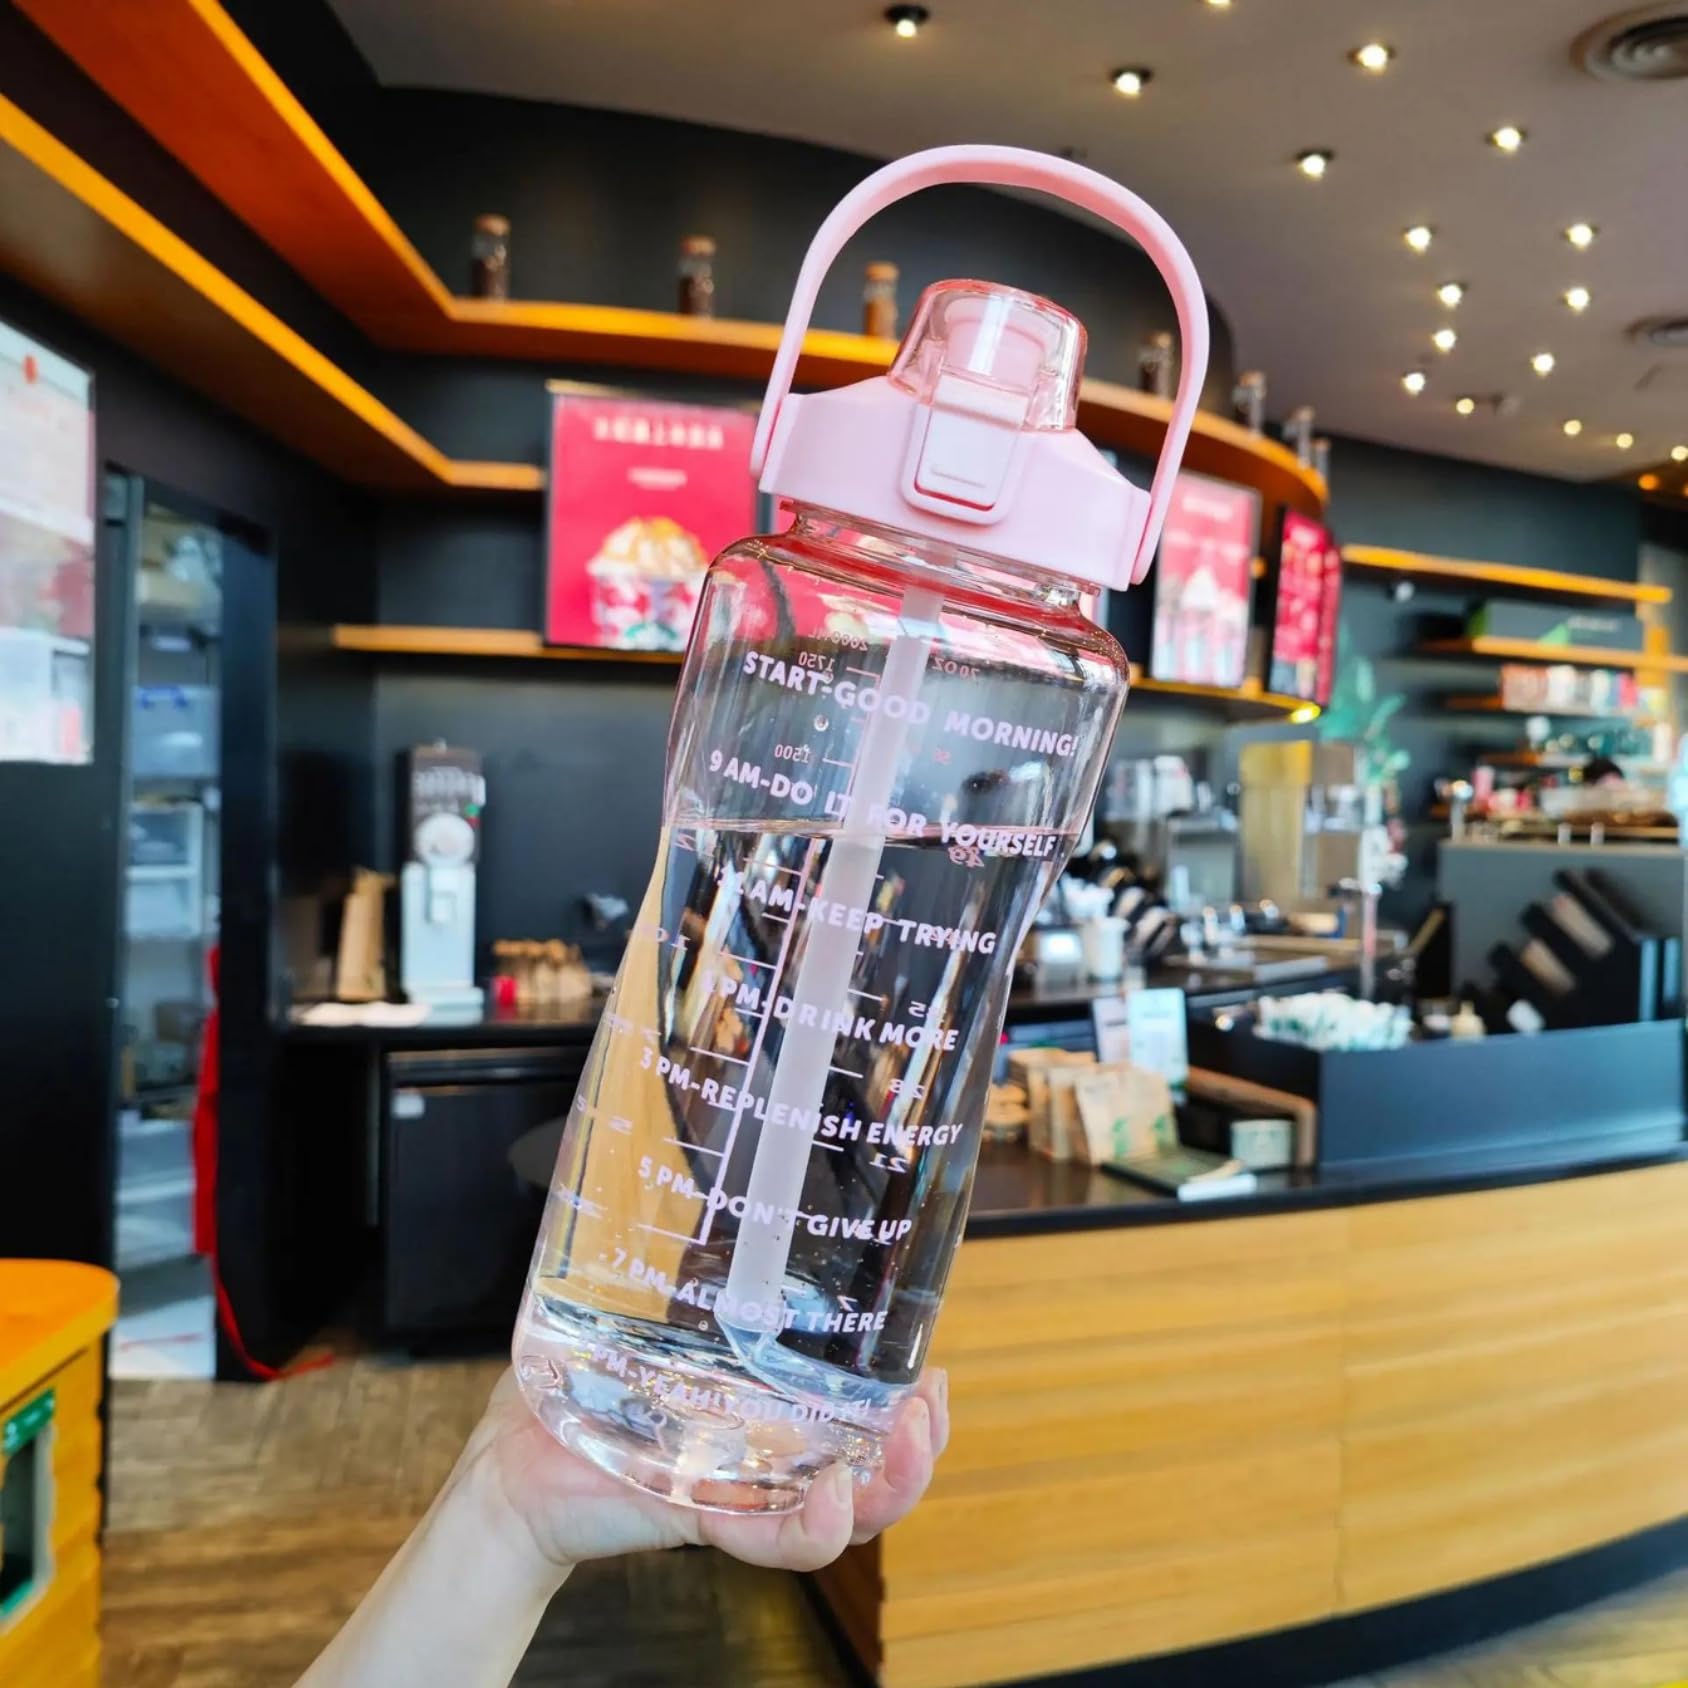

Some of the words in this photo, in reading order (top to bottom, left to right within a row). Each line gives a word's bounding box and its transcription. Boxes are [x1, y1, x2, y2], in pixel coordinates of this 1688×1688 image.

[944, 711, 1079, 757] MORNING!
[709, 750, 723, 772] 9
[724, 757, 813, 805] AM-DO
[941, 820, 1057, 858] YOURSELF
[899, 918, 996, 954] TRYING
[879, 1022, 959, 1051] MORE
[640, 1047, 653, 1069] 3
[866, 1122, 963, 1146] ENERGY
[638, 1156, 652, 1178] 5
[807, 1215, 875, 1239] GIVE
[878, 1219, 912, 1241] UP
[613, 1247, 627, 1269] 7
[807, 1310, 888, 1333] THERE
